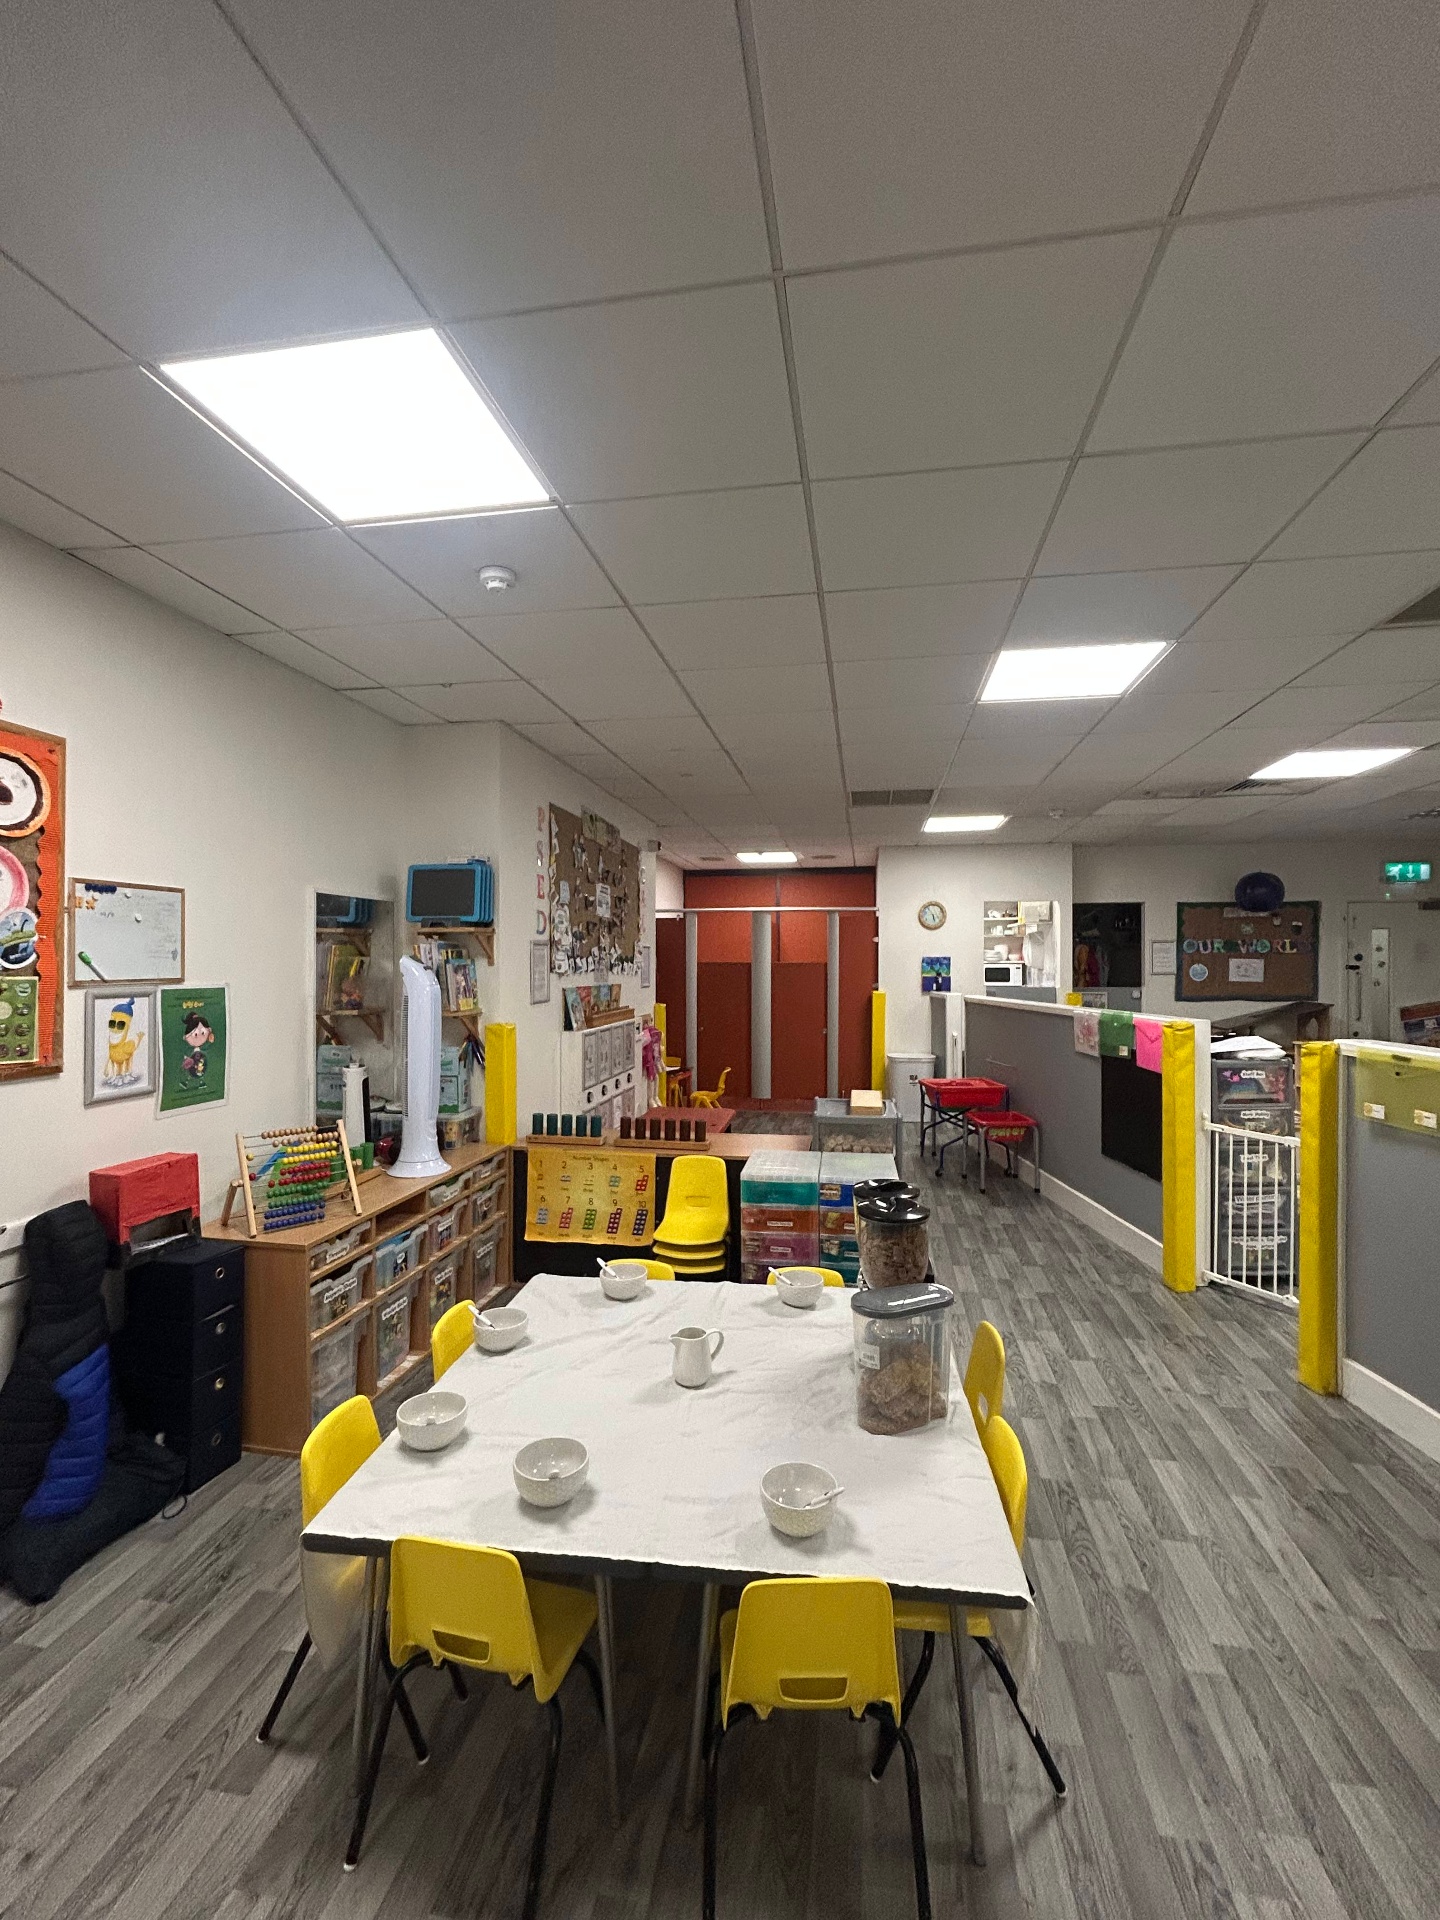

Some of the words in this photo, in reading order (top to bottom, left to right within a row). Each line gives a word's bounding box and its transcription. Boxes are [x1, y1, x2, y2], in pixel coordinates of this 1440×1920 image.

[1183, 939, 1225, 954] OUR
[561, 1161, 567, 1169] 2
[588, 1162, 593, 1170] 3
[639, 1165, 645, 1173] 5
[540, 1195, 546, 1203] 6
[565, 1196, 571, 1204] 7
[588, 1197, 594, 1206] 8
[612, 1199, 618, 1207] 9
[638, 1200, 647, 1208] 10
